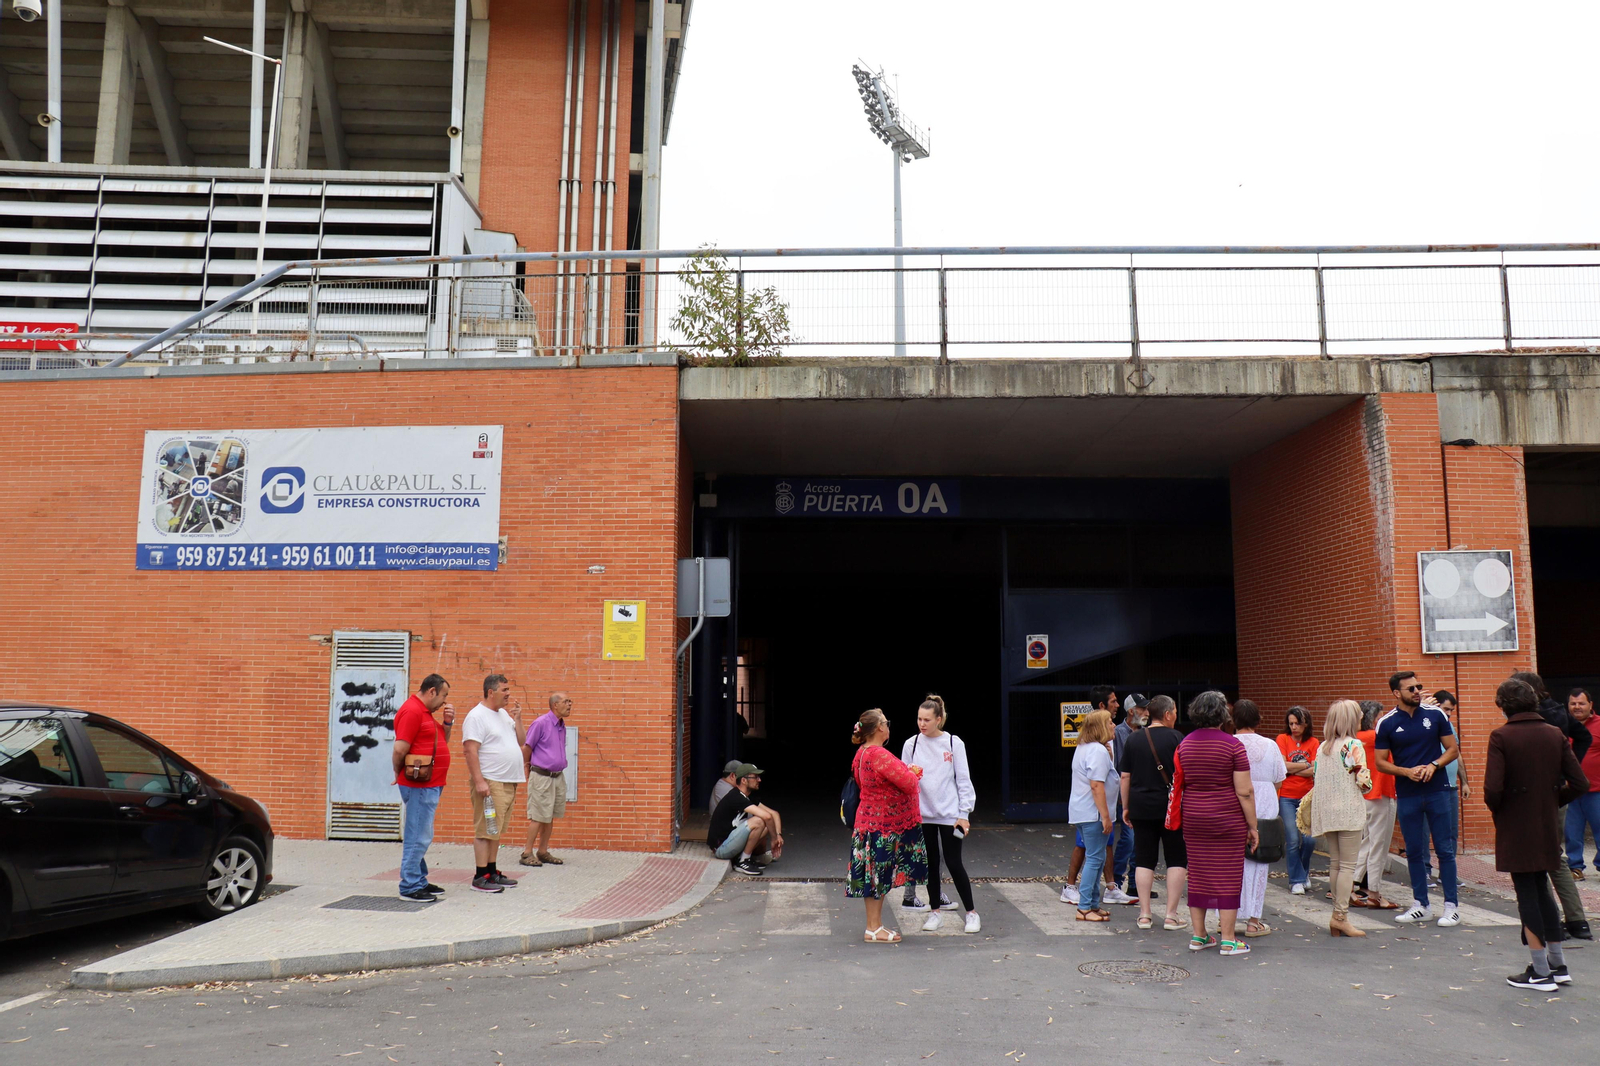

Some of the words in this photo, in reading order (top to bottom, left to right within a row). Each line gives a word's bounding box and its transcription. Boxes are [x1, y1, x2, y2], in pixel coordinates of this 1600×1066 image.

[313, 474, 445, 493] CLAU&PAUL,
[452, 474, 487, 491] S.L.
[804, 483, 841, 493] Acceso
[317, 498, 374, 508] EMPRESA
[378, 497, 480, 508] CONSTRUCTORA
[803, 495, 884, 512] PUERTA
[176, 546, 203, 566] 959
[206, 546, 225, 566] 87
[228, 546, 247, 566] 52
[249, 546, 267, 566] 41
[282, 545, 310, 566] 959
[313, 545, 331, 566] 61
[335, 545, 354, 566] 00
[358, 545, 376, 566] 11
[385, 545, 490, 555] info@clauypaul.es
[386, 557, 490, 567] www.clauypaul.es
